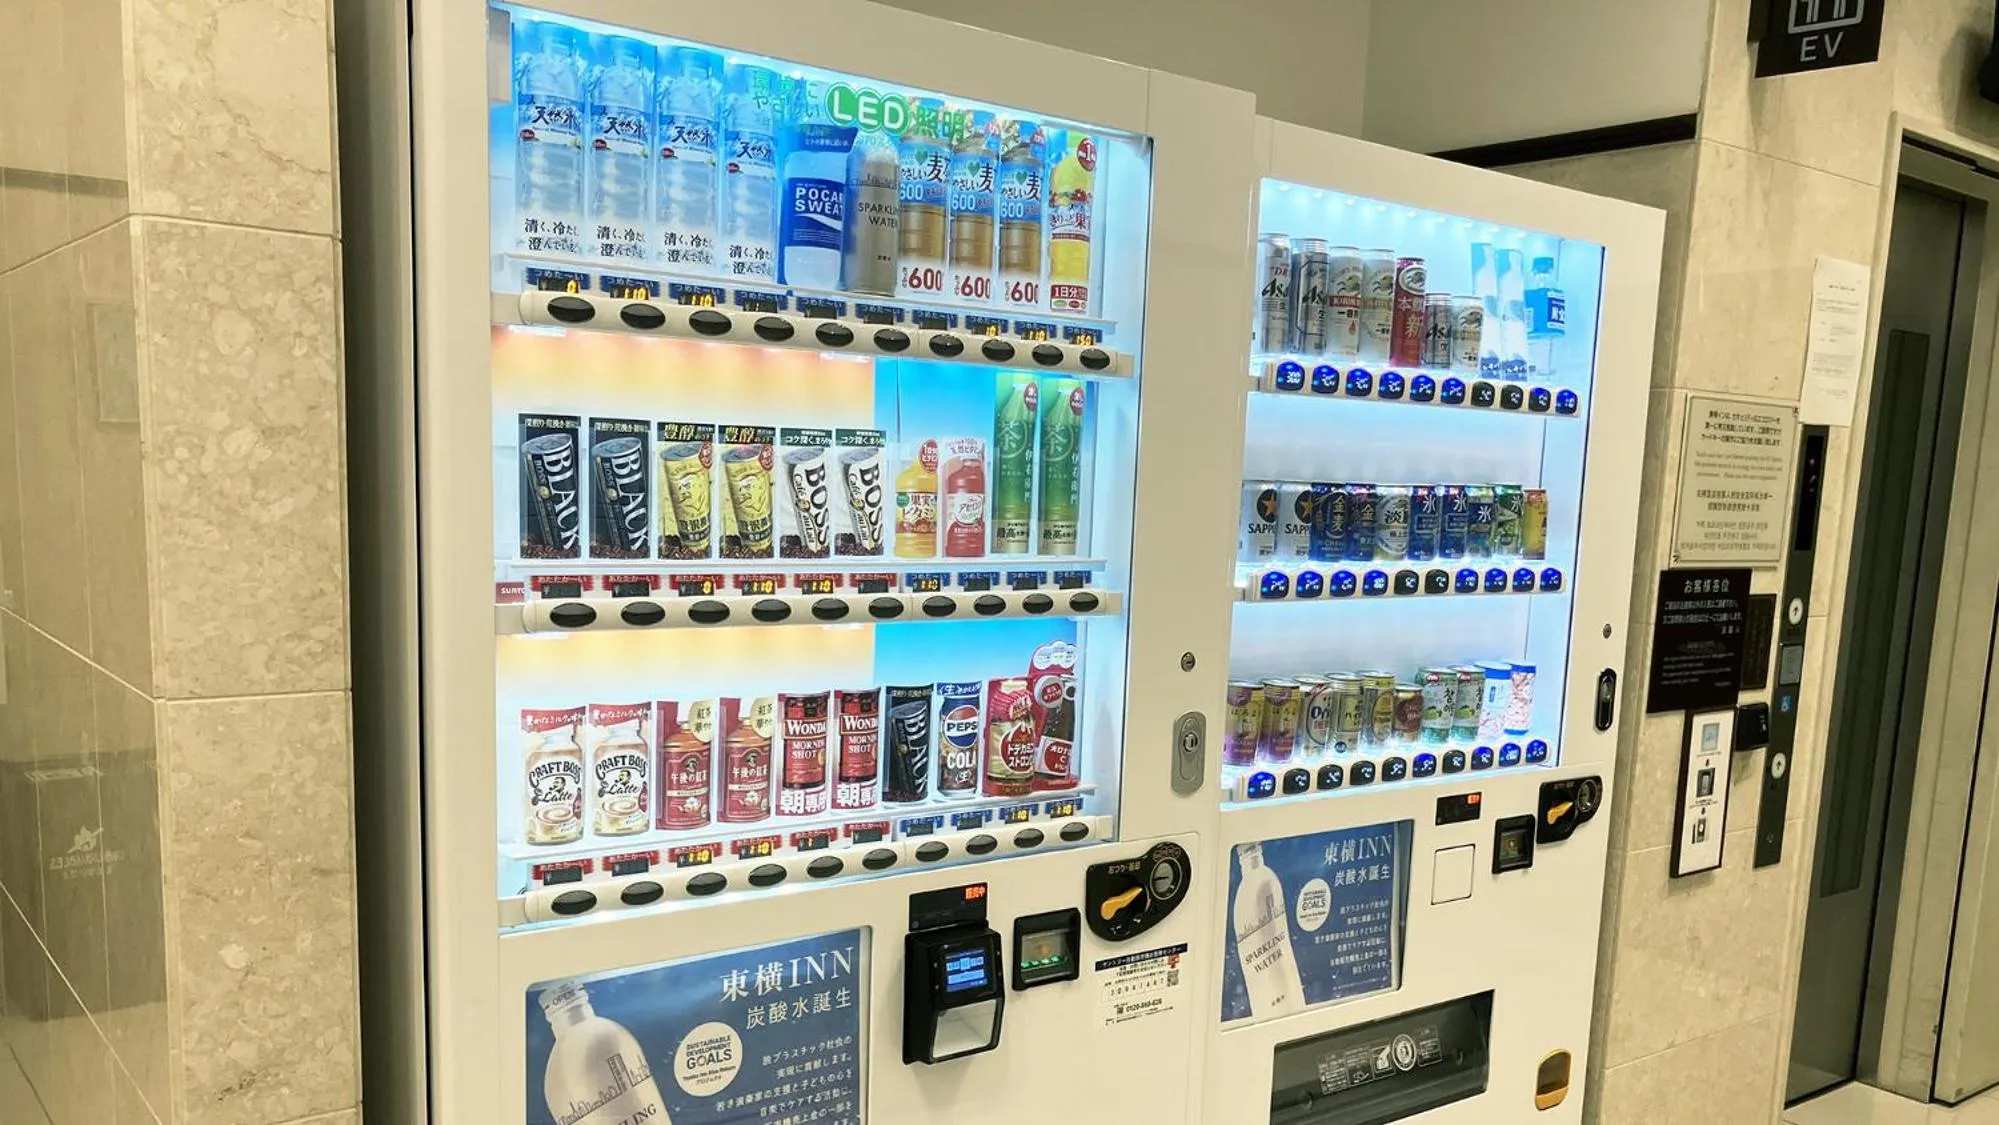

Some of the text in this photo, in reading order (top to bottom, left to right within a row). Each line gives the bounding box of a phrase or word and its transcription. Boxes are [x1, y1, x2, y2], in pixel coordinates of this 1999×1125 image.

[1800, 31, 1843, 62] EV
[833, 90, 904, 129] LED
[900, 183, 923, 200] 600
[953, 195, 975, 210] 600
[1001, 203, 1023, 217] 600
[908, 267, 943, 291] 600
[960, 275, 991, 298] 600
[998, 421, 1022, 452] 茶
[1045, 424, 1067, 454] 茶
[543, 446, 580, 550] BLACK
[611, 449, 648, 550] BLACK
[805, 463, 829, 545] BOSS
[860, 463, 883, 545] BOSS
[1332, 495, 1345, 532] 金麦
[753, 580, 772, 593] 110
[811, 580, 831, 593] 110
[920, 580, 938, 591] 110
[1684, 578, 1730, 594] お客様各位
[947, 721, 978, 733] PEPS
[792, 749, 816, 759] SHOT
[848, 744, 871, 754] SHOT
[904, 711, 930, 793] BLACK
[529, 761, 581, 788] CRAFT BOSS
[595, 755, 647, 780] CRAFT BOSS
[540, 790, 573, 803] Latte
[607, 783, 641, 796] Latte
[836, 783, 876, 808] 朝専
[688, 850, 709, 863] 110
[751, 841, 770, 855] 110
[1324, 835, 1392, 865] 東横INN
[1334, 864, 1391, 886] 炭酸水誕生
[1302, 898, 1328, 911] GOALS
[1245, 932, 1286, 964] SPARKLING
[1253, 949, 1284, 974] WATER
[719, 947, 853, 1002] 東横INN
[746, 987, 852, 1029] 炭酸水誕生
[686, 1042, 731, 1057] DEVELOPMENT
[687, 1035, 731, 1050] SUSTAINABLE
[687, 1049, 732, 1069] GOALS
